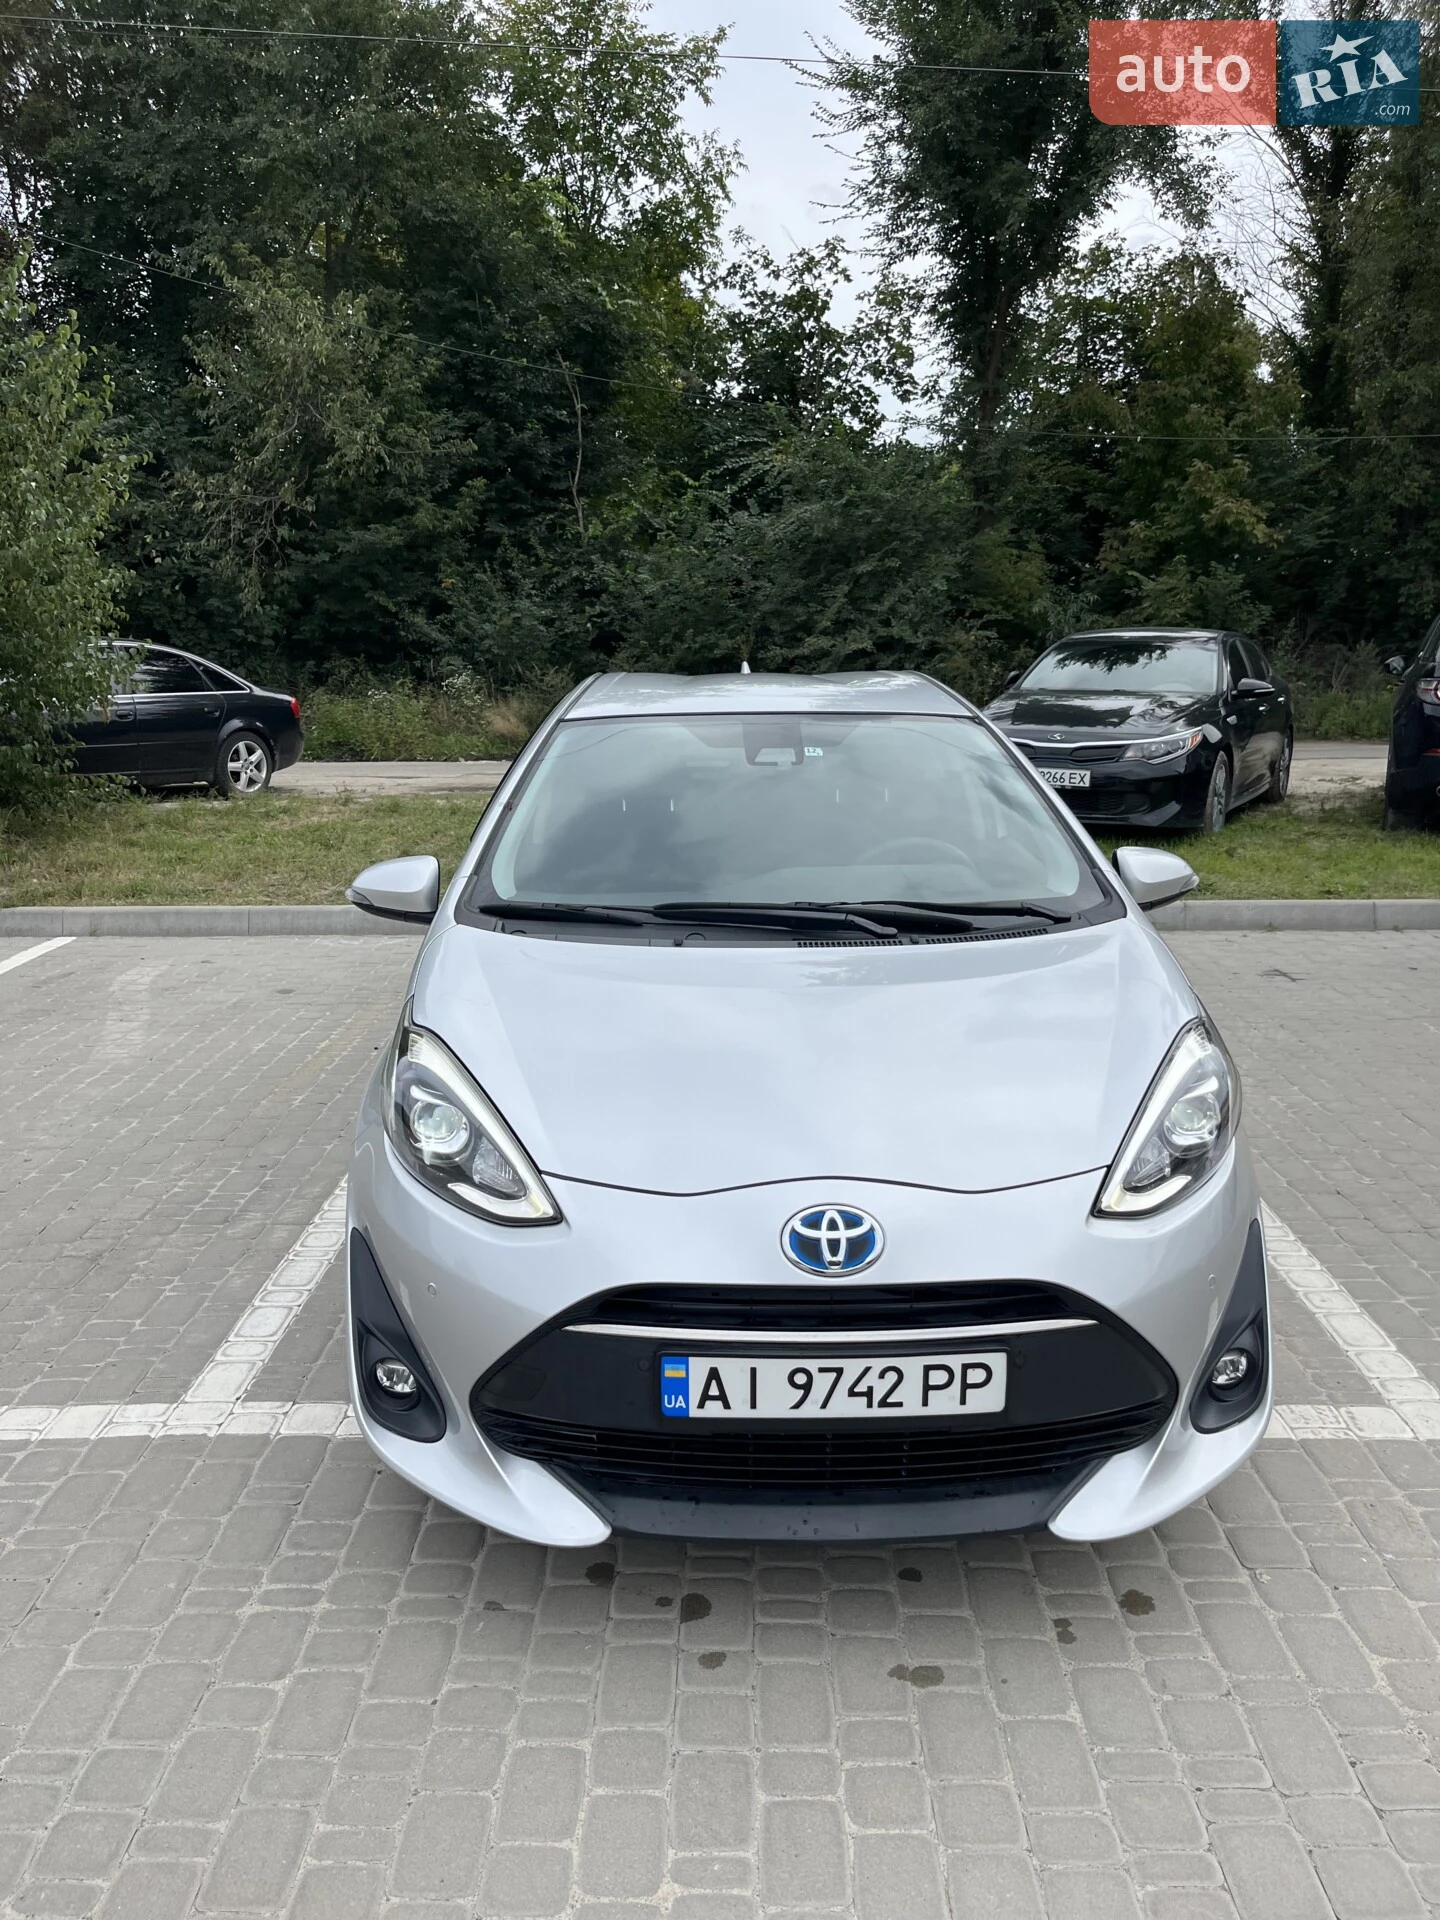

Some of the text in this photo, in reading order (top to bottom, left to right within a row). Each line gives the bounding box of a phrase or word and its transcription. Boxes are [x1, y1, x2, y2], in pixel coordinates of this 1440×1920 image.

[1068, 773, 1087, 785] EX
[697, 1362, 993, 1410] AI 9742 PP
[664, 1394, 686, 1408] UA
